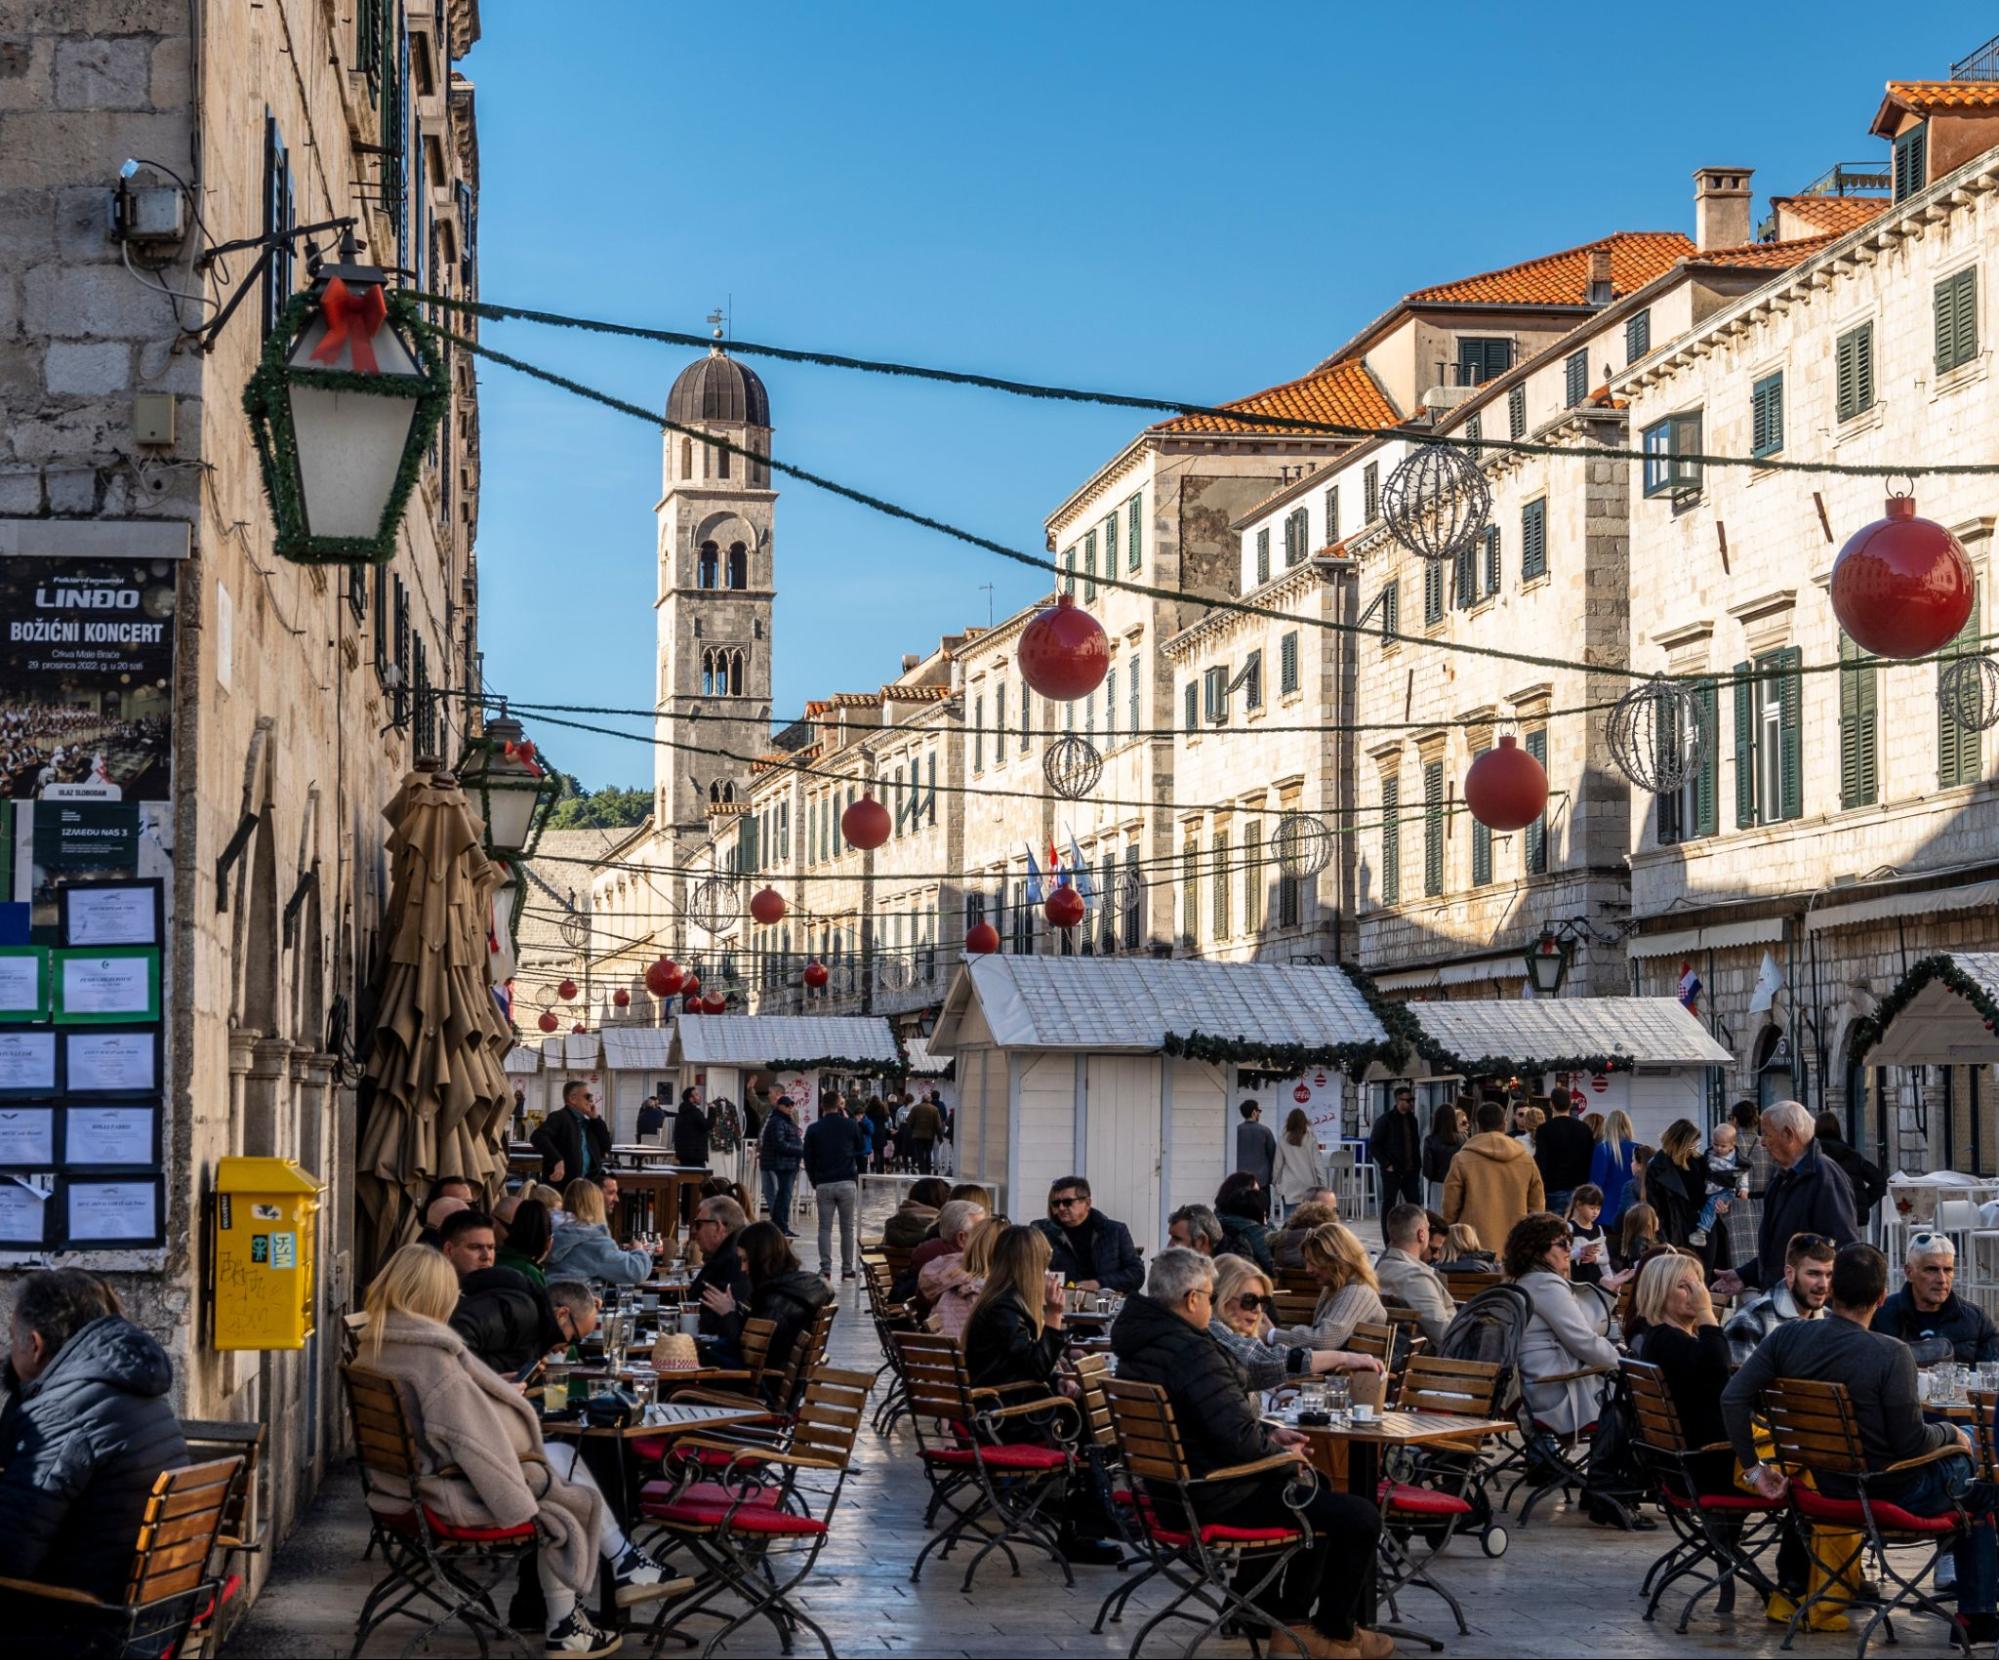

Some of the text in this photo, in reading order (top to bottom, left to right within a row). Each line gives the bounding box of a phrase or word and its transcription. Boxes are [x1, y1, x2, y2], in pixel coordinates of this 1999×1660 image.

[10, 618, 163, 643] BOŽIĆNI KONCERT
[42, 662, 76, 672] prosinca
[101, 828, 119, 837] NAS
[121, 829, 128, 837] 3
